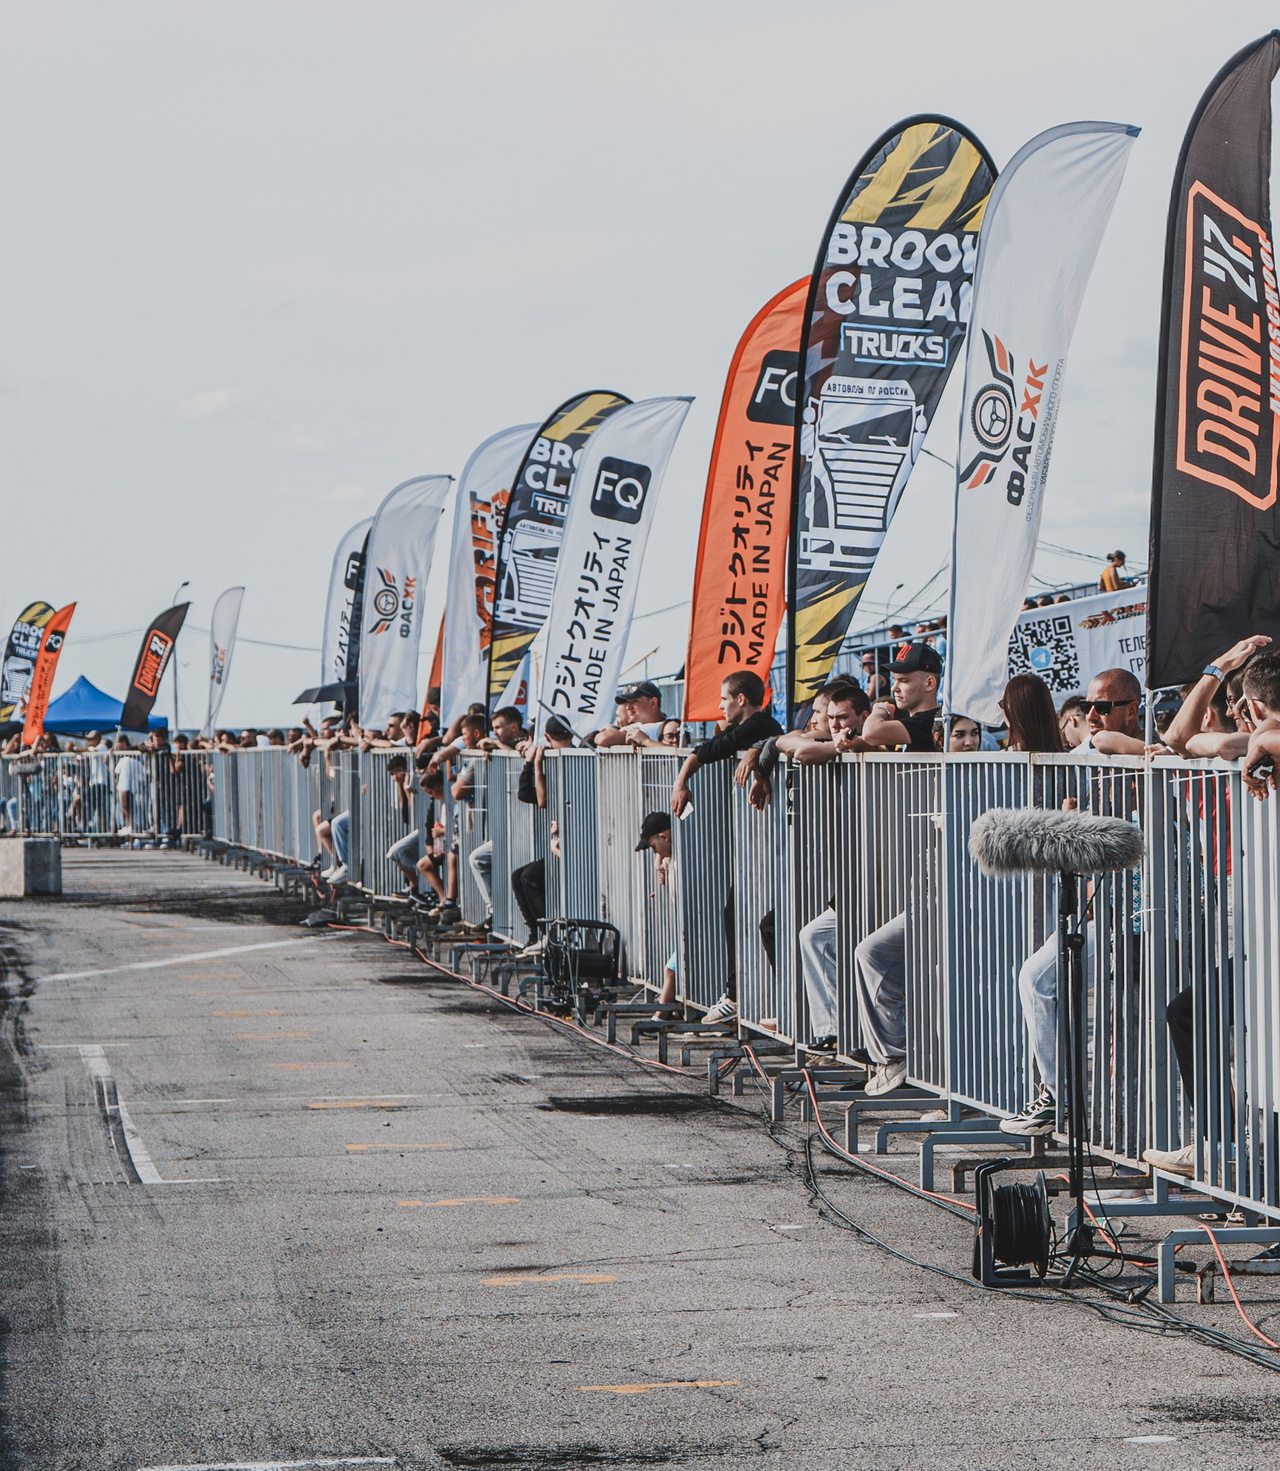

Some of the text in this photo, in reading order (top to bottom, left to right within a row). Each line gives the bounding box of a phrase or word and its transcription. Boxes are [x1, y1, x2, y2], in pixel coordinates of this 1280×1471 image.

[845, 330, 944, 360] TRUCKS
[879, 386, 909, 397] РОССИИ
[1196, 285, 1262, 476] DRIVE
[595, 470, 643, 510] FQ
[1006, 357, 1049, 507] ФАСХК
[1025, 357, 1065, 522] ФЕДЕРАЦИЯ АВТОМОБИЛЬНОГО СПОРТА
[399, 575, 417, 638] ФАСХК
[552, 531, 610, 708] フジトクオリティ
[577, 536, 632, 714] MADE IN JAPAN
[718, 440, 765, 664] フジトクオリティ
[746, 442, 791, 666] MADE IN JAPAN
[140, 650, 163, 689] DRIVE
